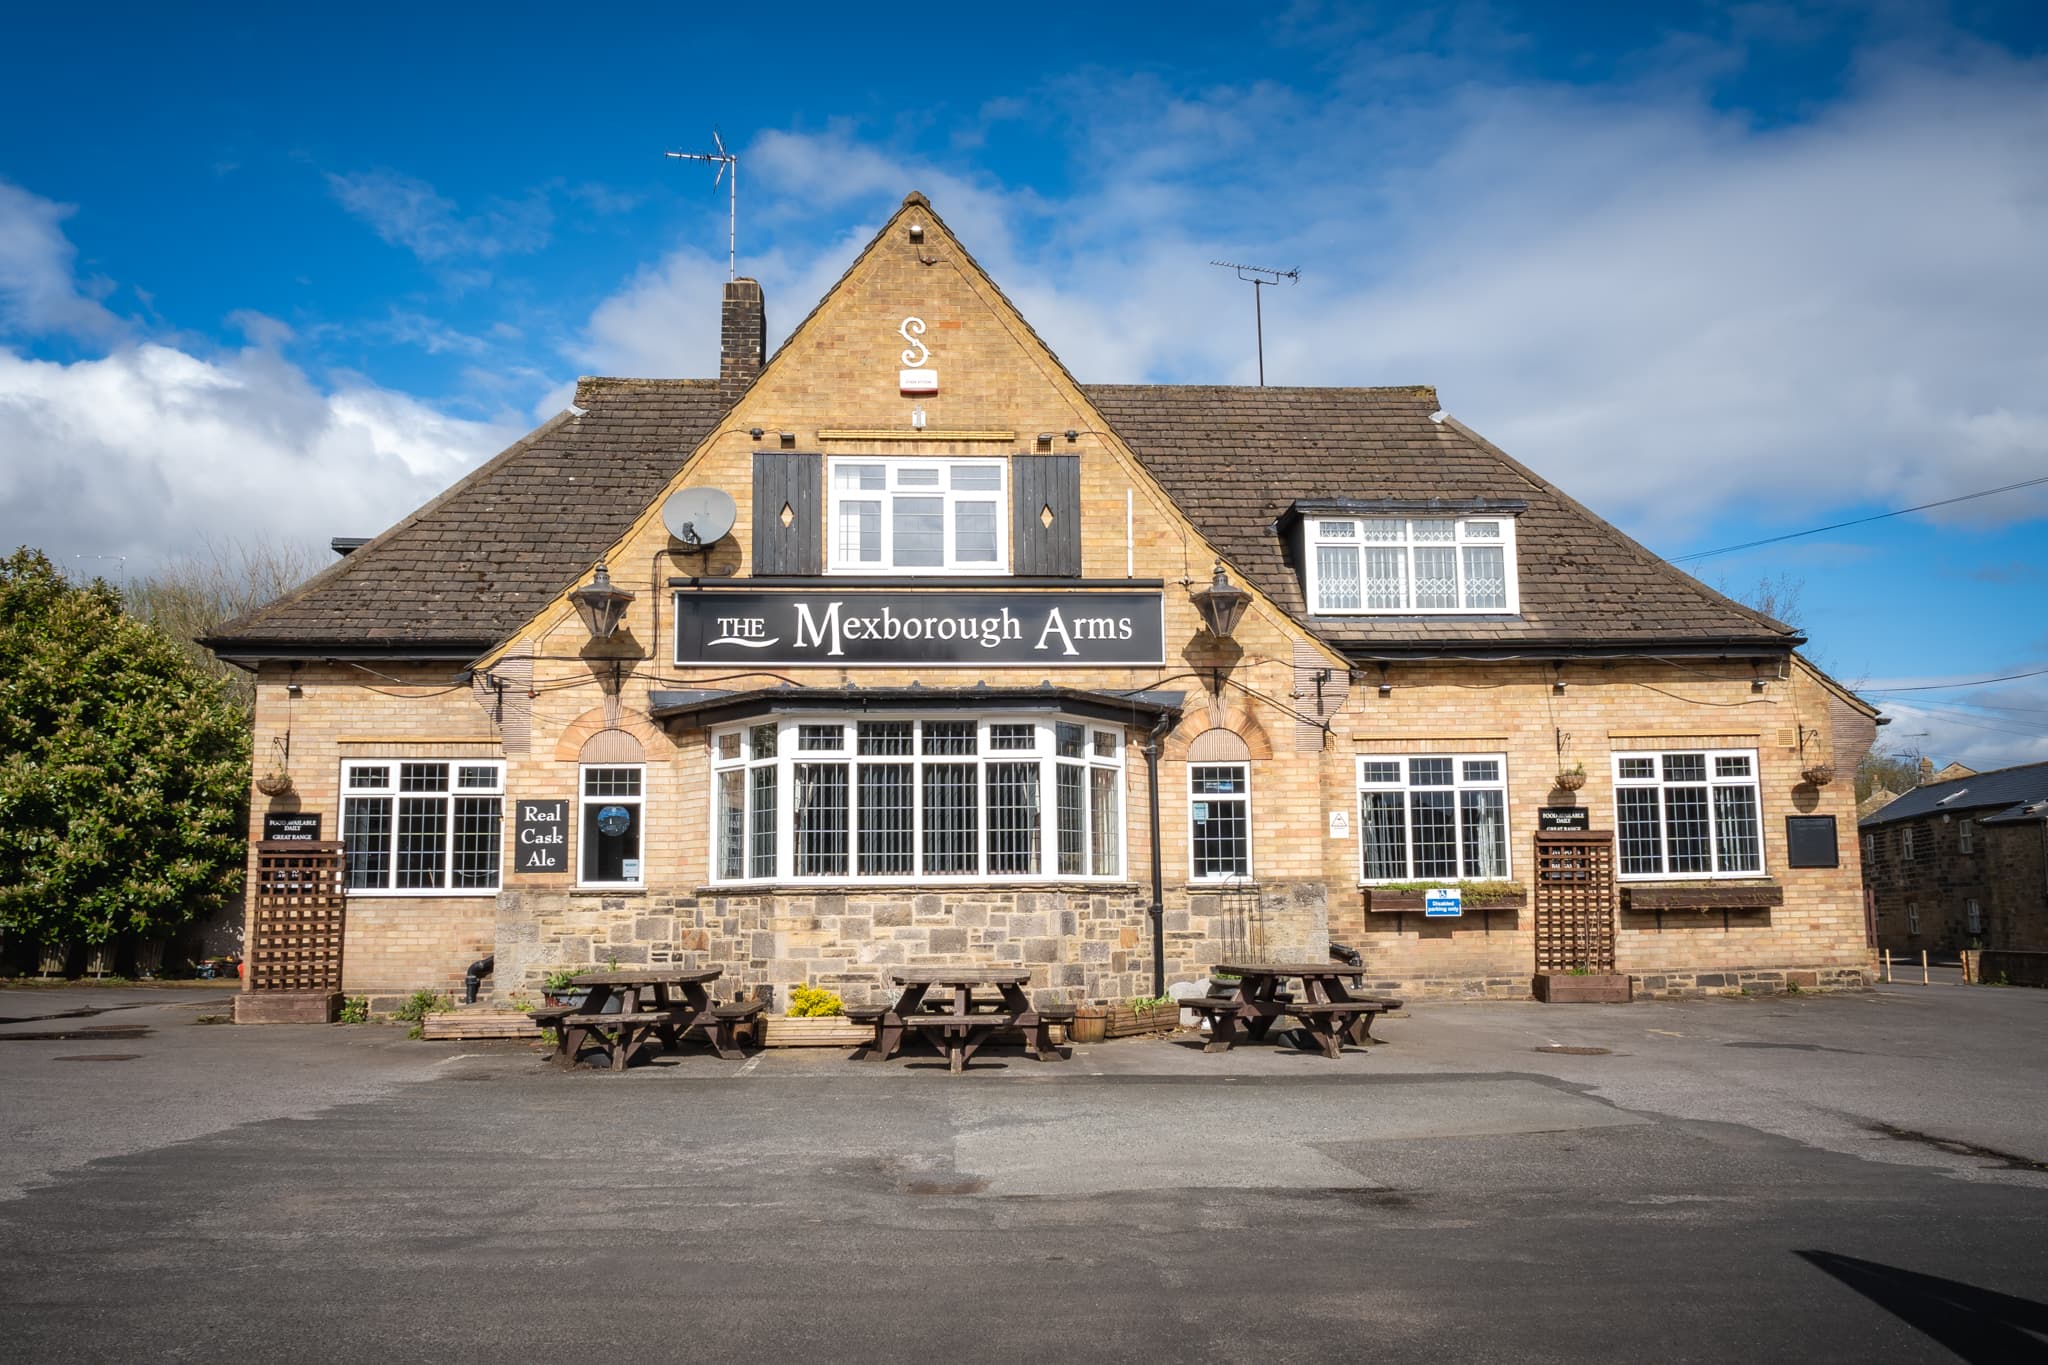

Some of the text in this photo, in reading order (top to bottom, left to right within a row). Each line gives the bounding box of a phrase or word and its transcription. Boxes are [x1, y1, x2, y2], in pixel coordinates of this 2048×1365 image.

[717, 602, 1133, 656] THE Mexborough Arms
[524, 804, 561, 822] Real
[521, 826, 564, 844] Cask
[526, 848, 556, 867] Ale
